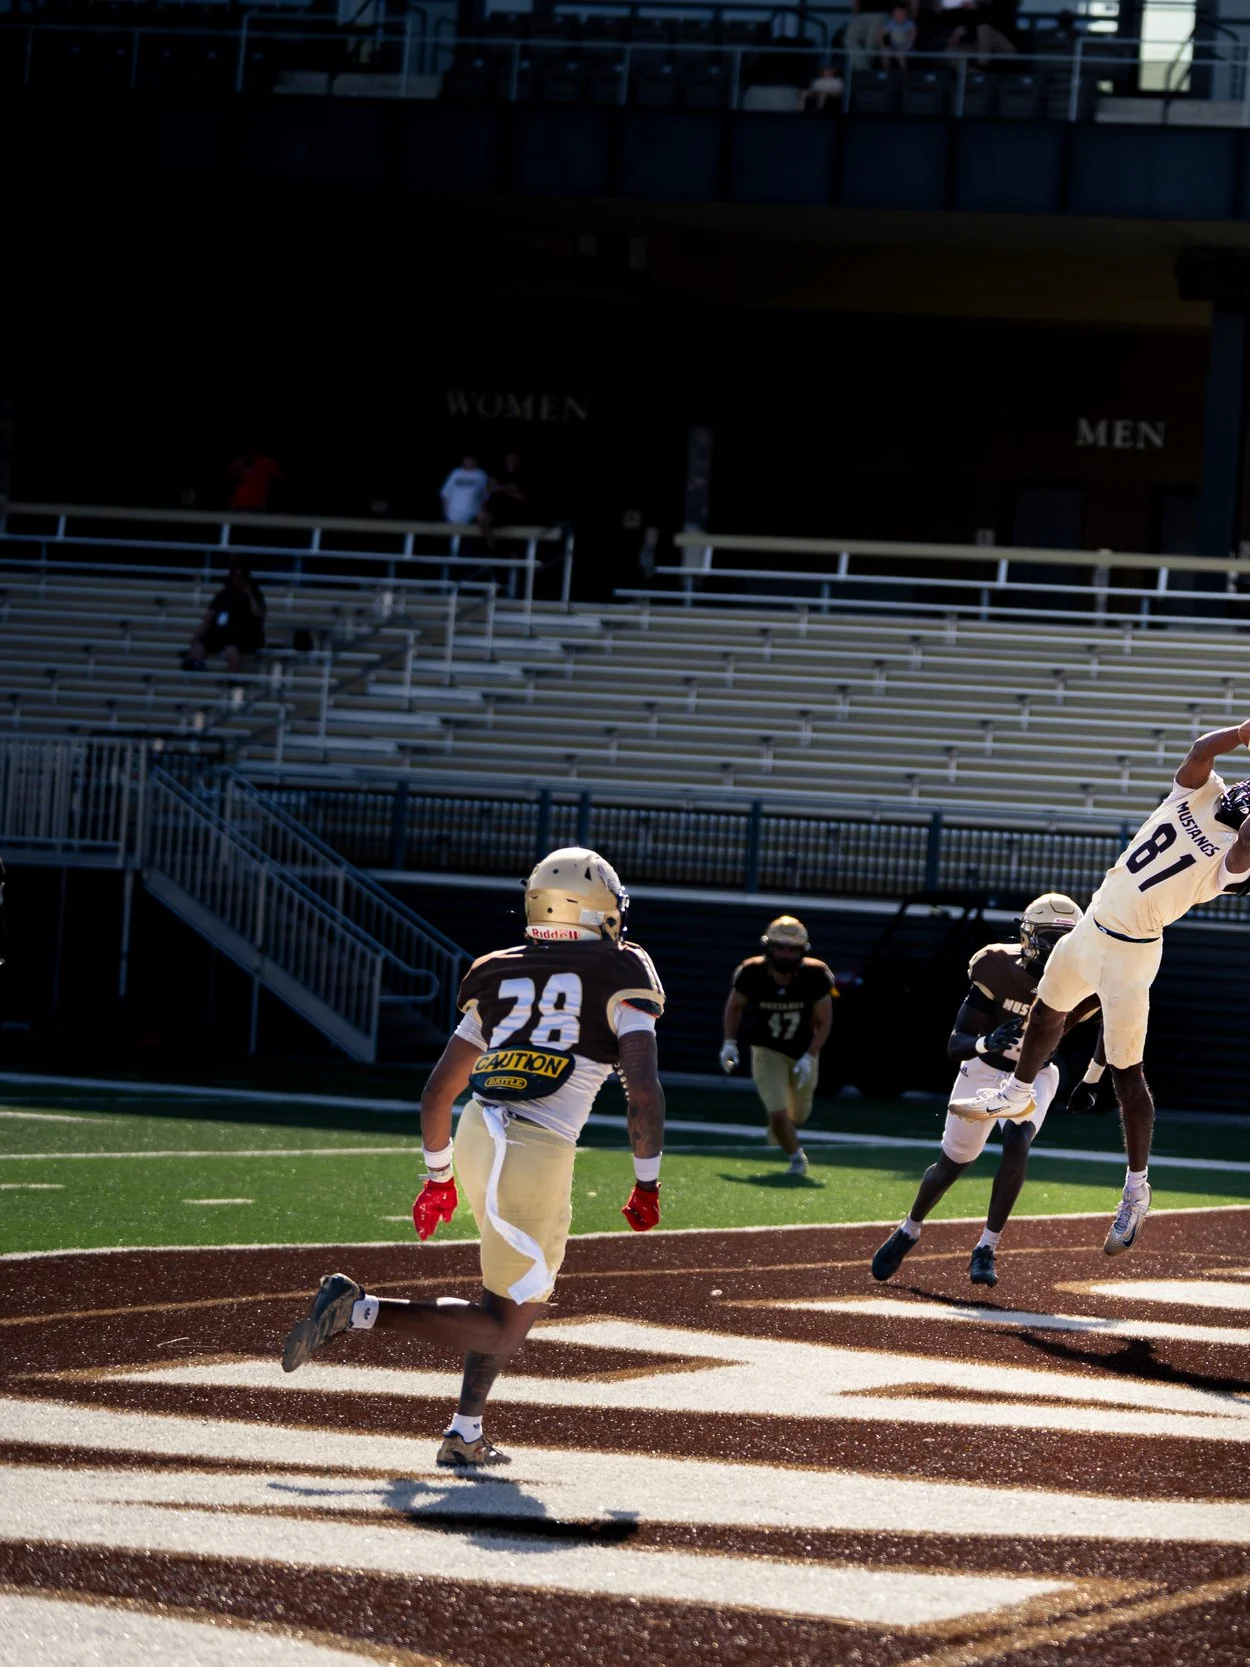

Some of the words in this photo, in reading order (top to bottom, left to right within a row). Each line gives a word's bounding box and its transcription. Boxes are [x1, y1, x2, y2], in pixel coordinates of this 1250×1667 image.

[445, 387, 592, 424] WOMEN
[1074, 416, 1167, 450] MEN
[1177, 801, 1221, 857] MUSTANGS
[1126, 822, 1197, 892] 81
[532, 928, 578, 940] Riddell
[1002, 998, 1030, 1016] MUS
[768, 1011, 801, 1041] 47
[475, 1052, 562, 1075] CAUTION
[487, 1077, 524, 1087] BATTLE
